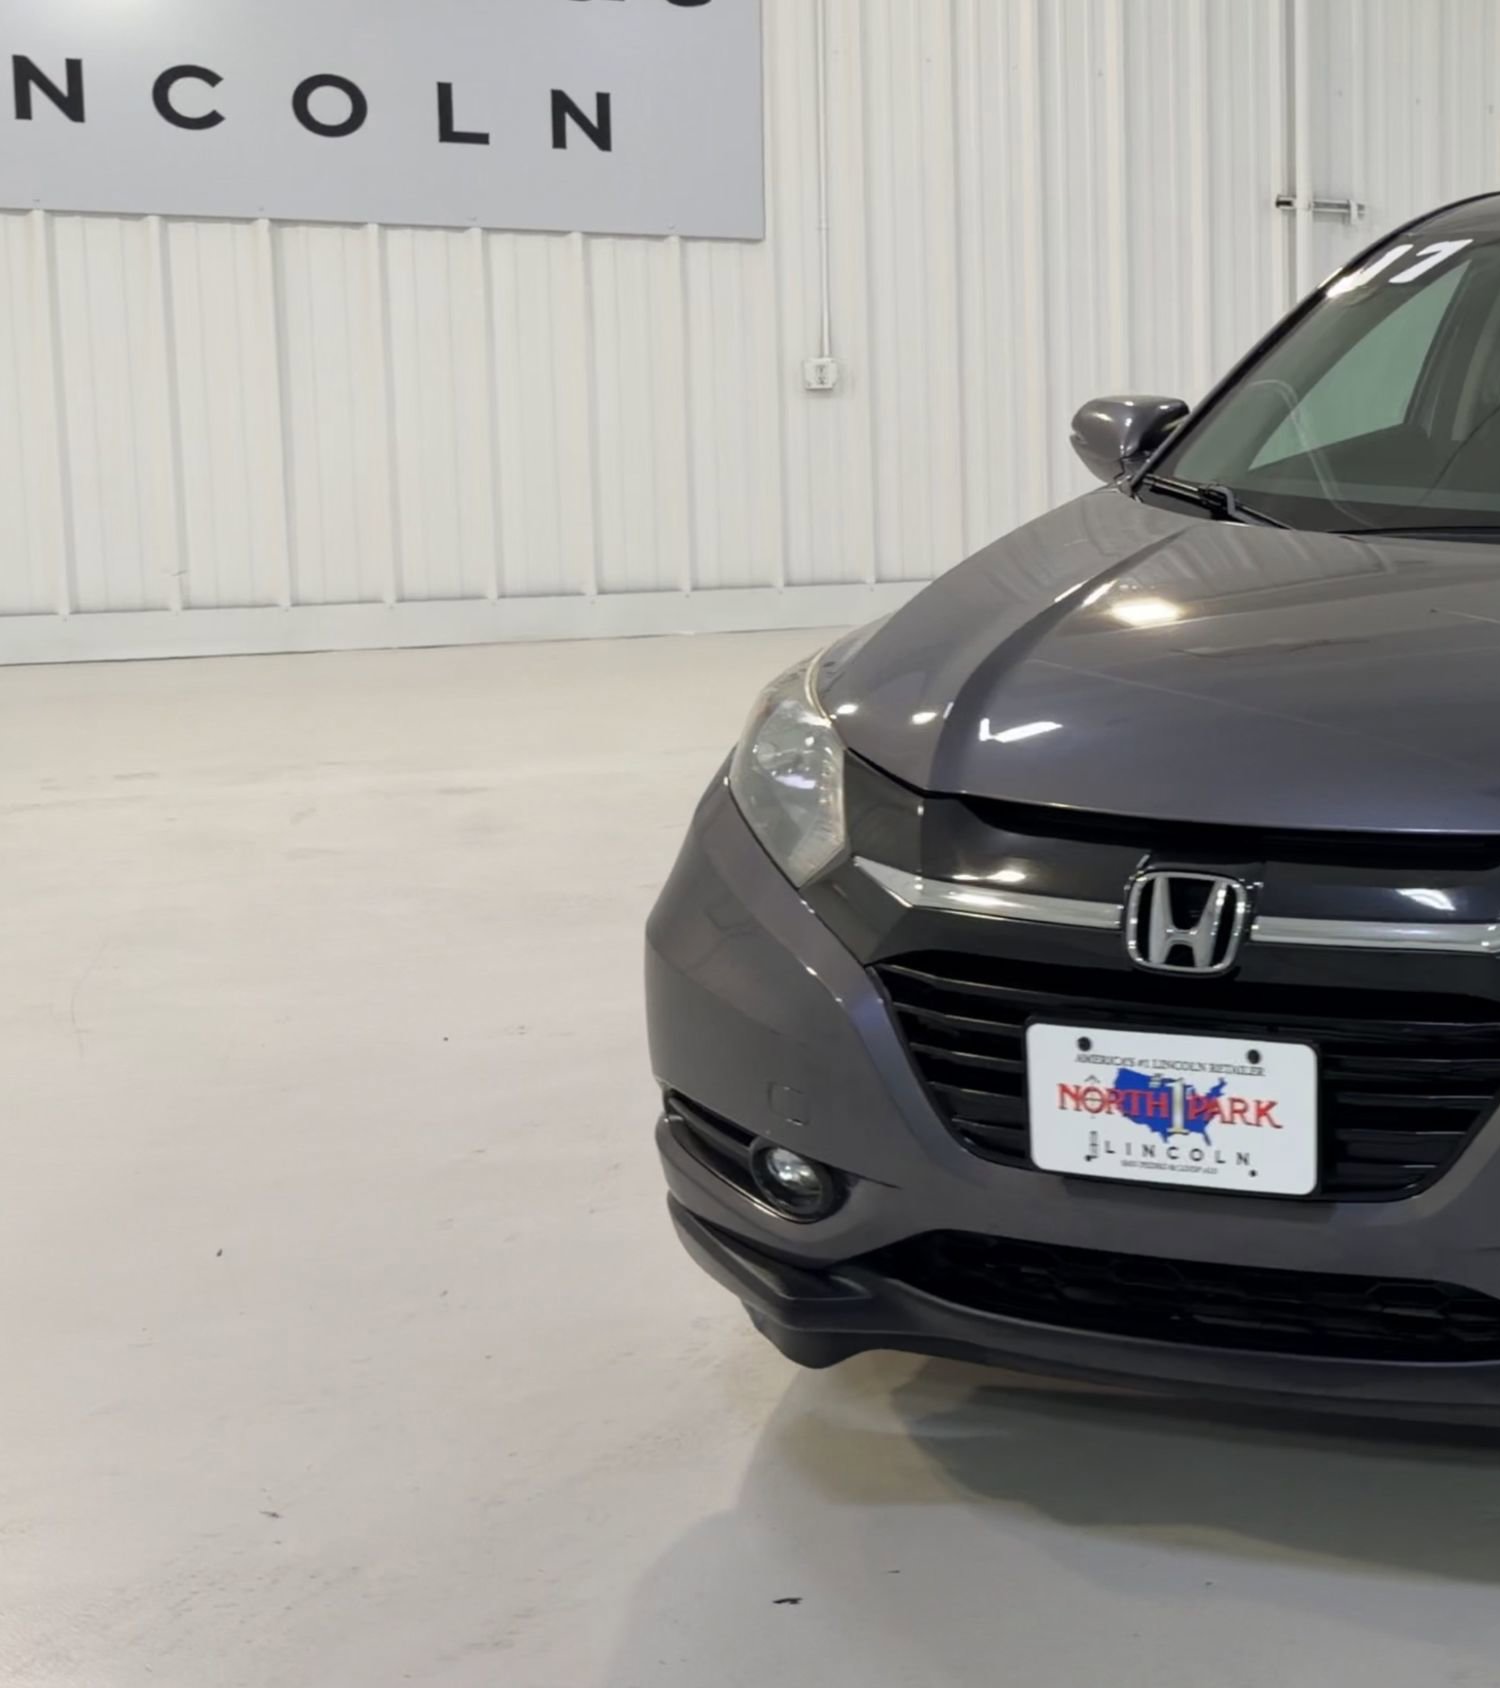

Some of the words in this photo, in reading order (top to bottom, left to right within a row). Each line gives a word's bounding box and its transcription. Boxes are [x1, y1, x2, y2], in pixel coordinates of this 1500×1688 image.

[1328, 239, 1475, 298] 17
[1151, 1059, 1206, 1073] LINCOLN
[1057, 1083, 1169, 1121] NORTH
[1189, 1091, 1283, 1129] PARK
[1104, 1140, 1251, 1166] LINCOLN
